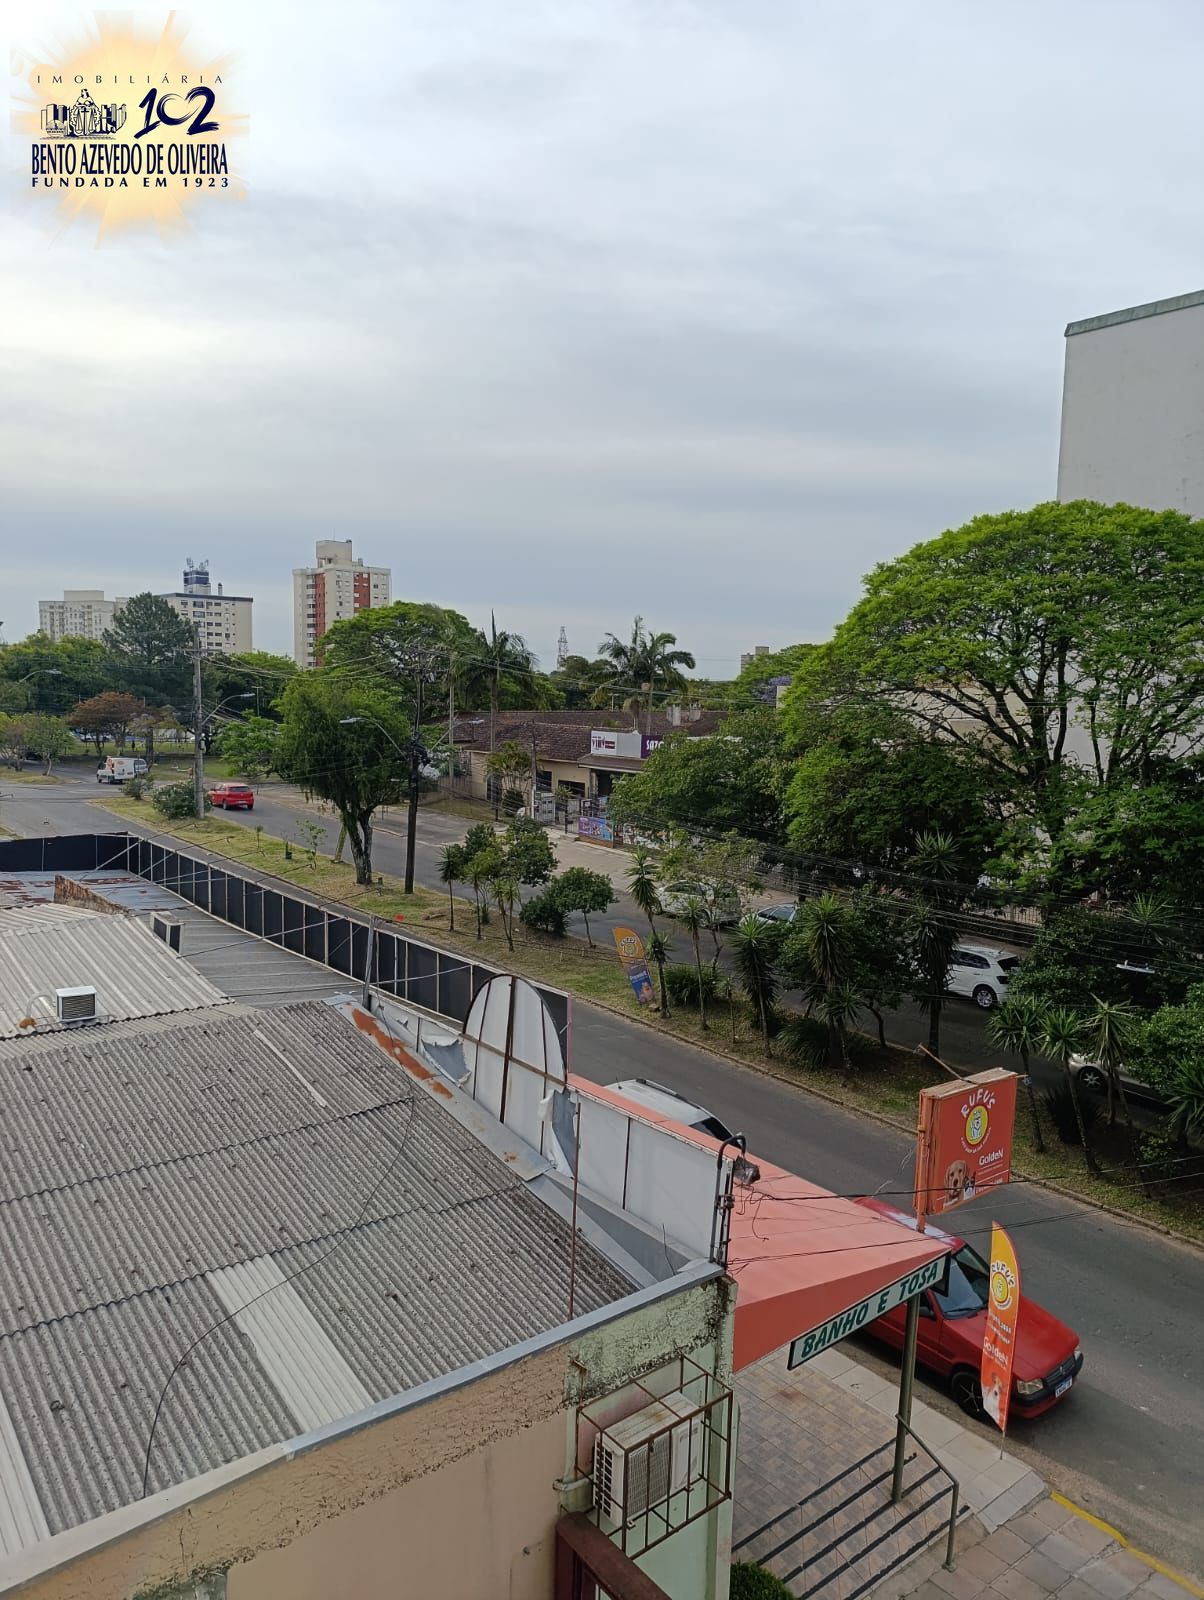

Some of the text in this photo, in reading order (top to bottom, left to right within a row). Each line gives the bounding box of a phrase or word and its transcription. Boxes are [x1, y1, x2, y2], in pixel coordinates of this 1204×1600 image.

[801, 1262, 938, 1358] BANHO E TOSA
